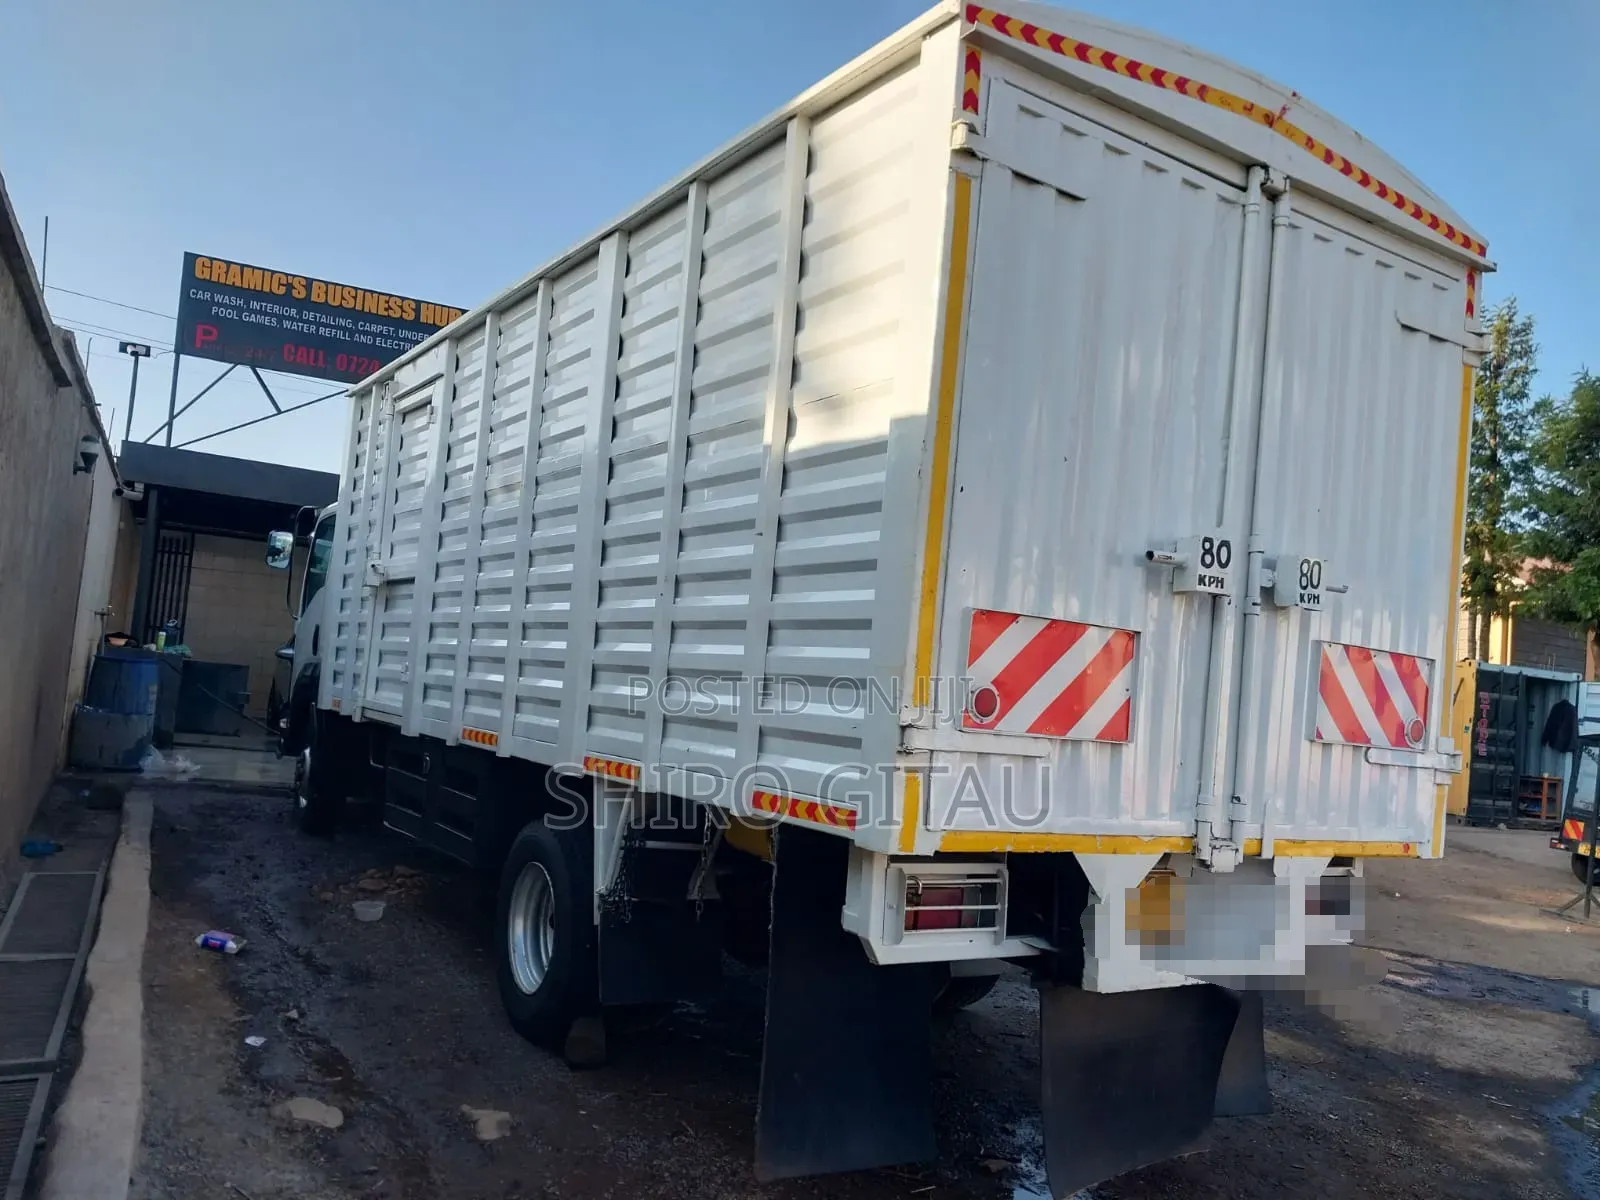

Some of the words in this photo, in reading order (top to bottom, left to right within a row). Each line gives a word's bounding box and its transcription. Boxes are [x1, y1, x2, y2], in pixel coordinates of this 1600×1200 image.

[194, 256, 307, 299] GRAMIC'S
[310, 280, 416, 321] BUSINESS
[189, 288, 212, 301] CAR
[214, 293, 247, 309] WASH,
[249, 300, 300, 319] INTERIOR,
[358, 321, 396, 338] CARPET,
[211, 306, 240, 320] POOL
[282, 319, 317, 335] WATER
[318, 326, 351, 341] REFILL
[353, 333, 374, 345] AND
[283, 343, 326, 369] CALL
[1200, 536, 1232, 569] 80
[1197, 573, 1225, 589] KPH
[1299, 558, 1322, 591] 80
[1299, 592, 1320, 605] KPH
